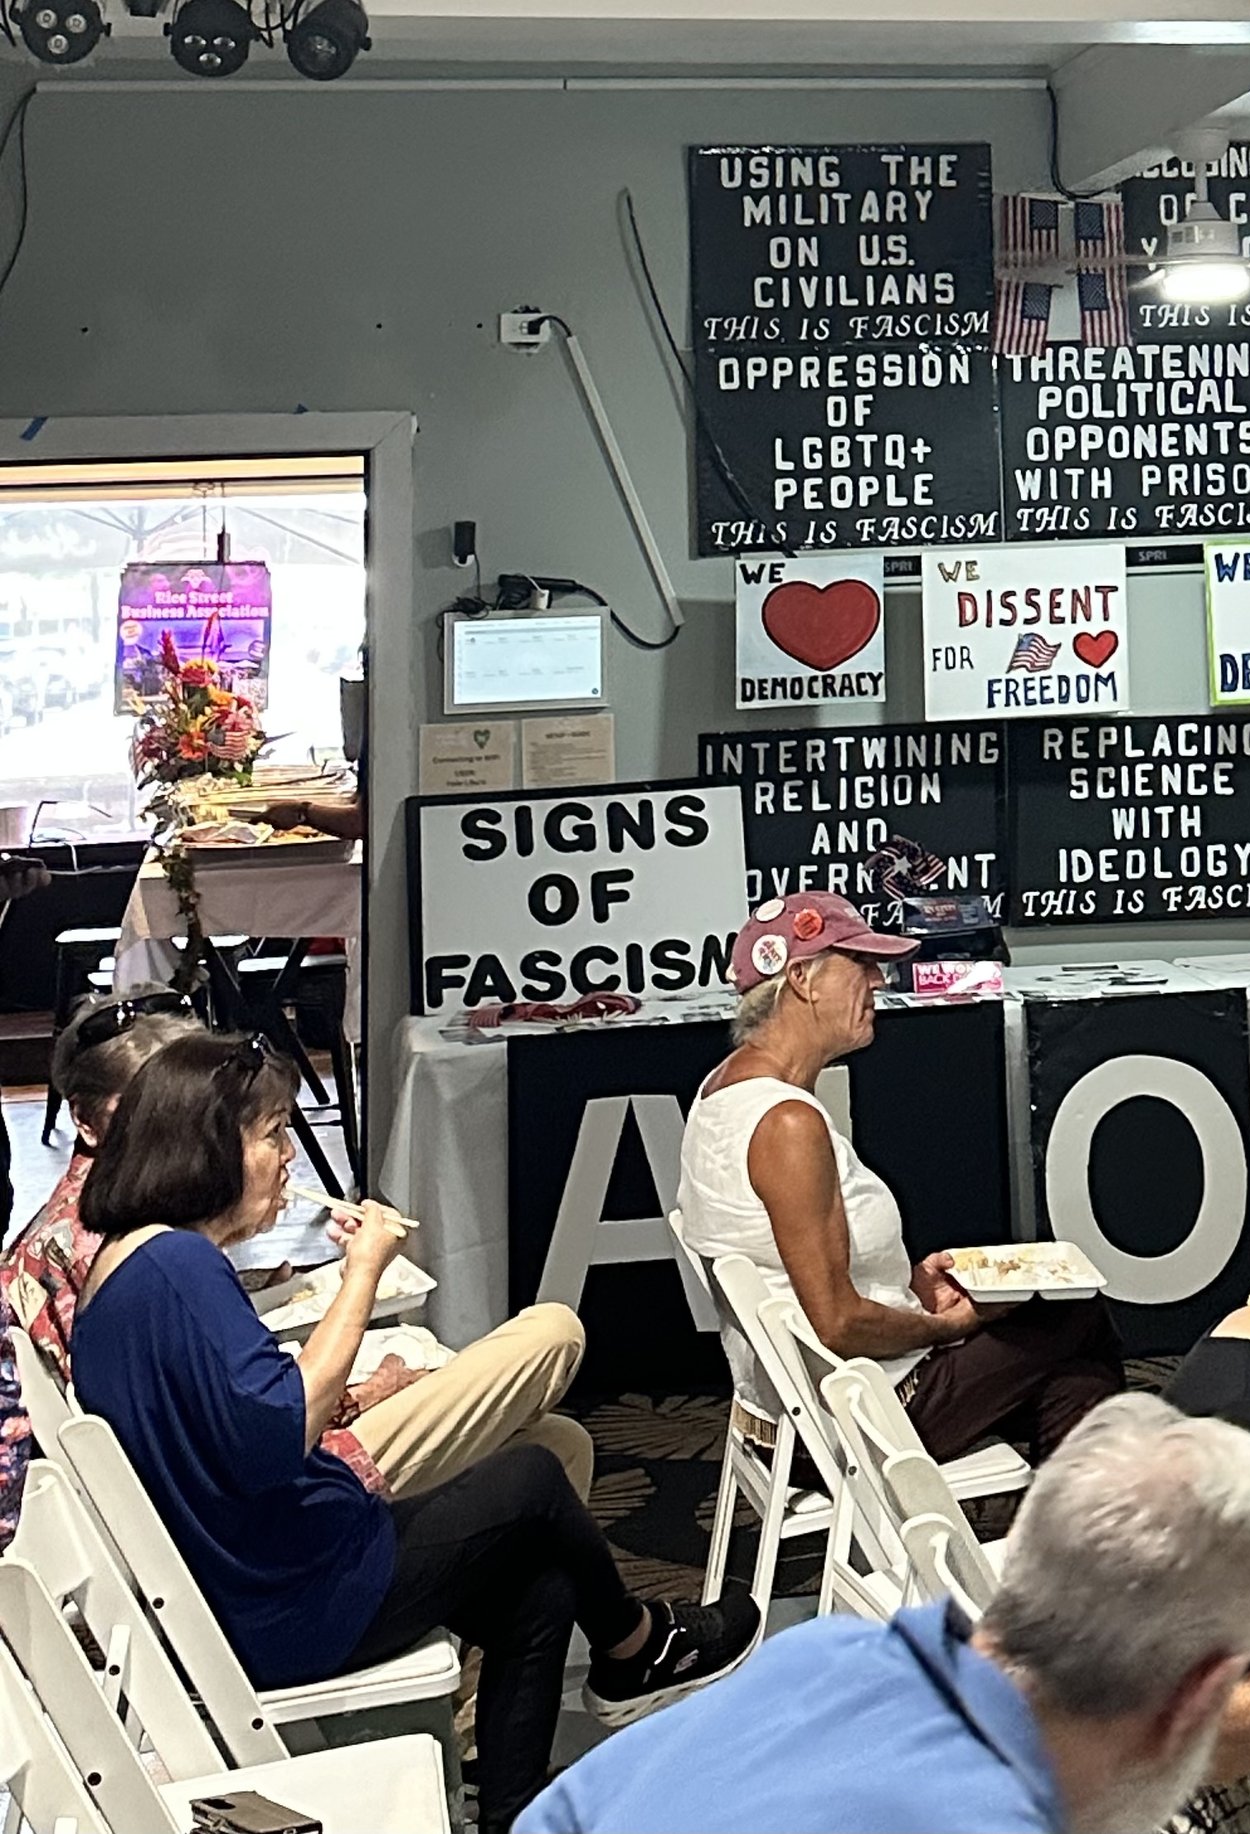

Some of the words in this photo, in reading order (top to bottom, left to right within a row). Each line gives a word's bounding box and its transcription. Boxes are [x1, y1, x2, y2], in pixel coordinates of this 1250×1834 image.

[720, 155, 840, 189] USING
[881, 154, 958, 188] THE
[743, 189, 933, 228] MILITARY
[769, 235, 819, 270] ON
[859, 233, 916, 267] U.S.
[753, 272, 956, 309] CIVILIANS
[703, 315, 780, 342] THIS
[800, 316, 831, 341] IS
[849, 310, 990, 339] FASCISM
[1138, 303, 1211, 328] THIS
[718, 352, 970, 391] OPPRESSION
[826, 393, 875, 427] OF
[1038, 378, 1248, 421] POLITICAL
[774, 433, 933, 471] LGBTQ+
[774, 472, 935, 511] PEOPLE
[1014, 466, 1113, 501] WITH
[710, 520, 788, 546] THIS
[804, 520, 838, 545] IS
[855, 510, 999, 541] FASCISM
[1016, 505, 1091, 533] THIS
[1107, 506, 1138, 531] IS
[740, 562, 786, 585] WE
[937, 559, 981, 583] WE
[958, 584, 1119, 629] DISSENT
[932, 645, 974, 672] FOR
[740, 671, 884, 703] DEMOCRACY
[986, 670, 1118, 709] FREEDOM
[704, 731, 1000, 776] INTERTWINING
[754, 772, 942, 815] RELIGION
[1069, 761, 1235, 801] SCIENCE
[460, 794, 711, 862] SIGNS
[810, 817, 888, 856] AND
[1112, 804, 1202, 841] WITH
[527, 867, 635, 927] OF
[1021, 888, 1097, 918] THIS
[1113, 889, 1146, 916] IS
